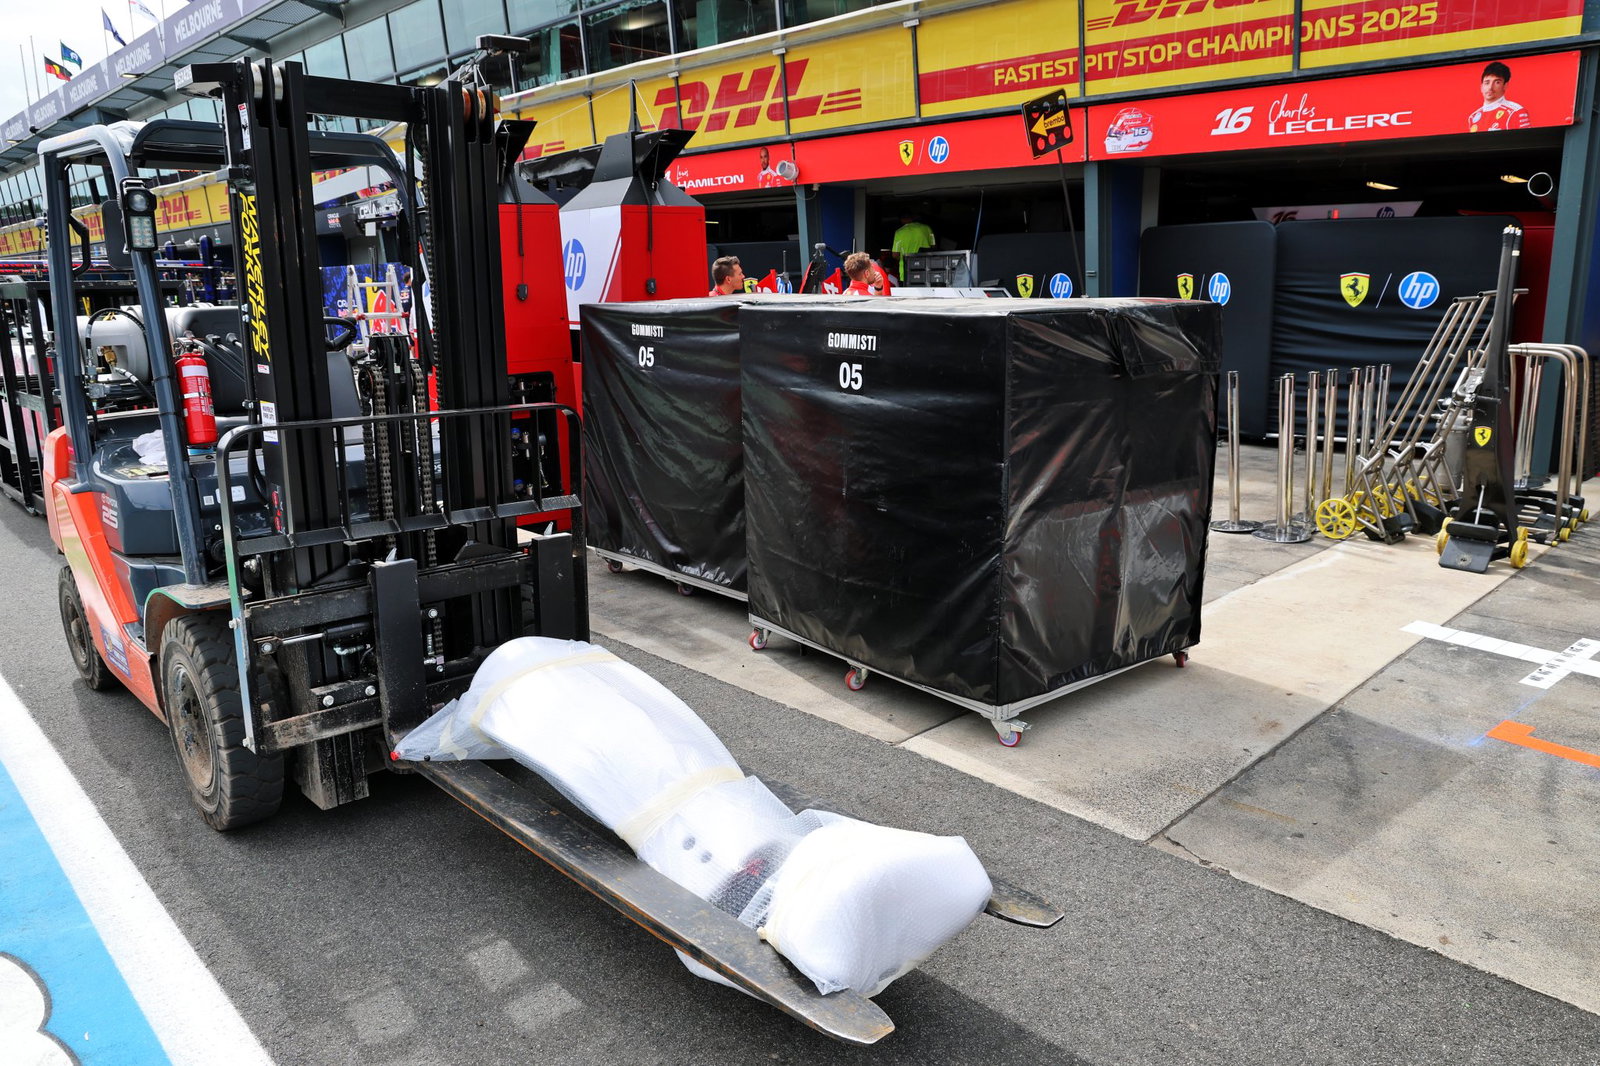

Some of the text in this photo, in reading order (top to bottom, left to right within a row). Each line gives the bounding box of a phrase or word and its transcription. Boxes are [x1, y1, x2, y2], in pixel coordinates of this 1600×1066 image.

[174, 0, 223, 43] MELBOURNE
[994, 1, 1438, 86] FASTEST PIT STOP CHAMPIONS 2025
[114, 42, 152, 78] MELBOURNE
[654, 58, 823, 133] DHL
[1268, 93, 1315, 123] Charles
[1044, 115, 1065, 128] brembo
[1133, 127, 1149, 137] 16
[1210, 106, 1255, 136] 16
[1268, 111, 1413, 136] LECLERC
[929, 137, 948, 163] hp
[677, 175, 744, 188] HAMILTON
[248, 195, 271, 361] WAVERLEY
[564, 239, 585, 291] hp
[1051, 273, 1071, 298] hp
[1210, 273, 1229, 303] hp
[1402, 272, 1436, 308] hp
[631, 323, 664, 339] GOMMISTI
[828, 332, 877, 352] GOMMISTI
[638, 346, 654, 367] 05
[839, 362, 863, 390] 05
